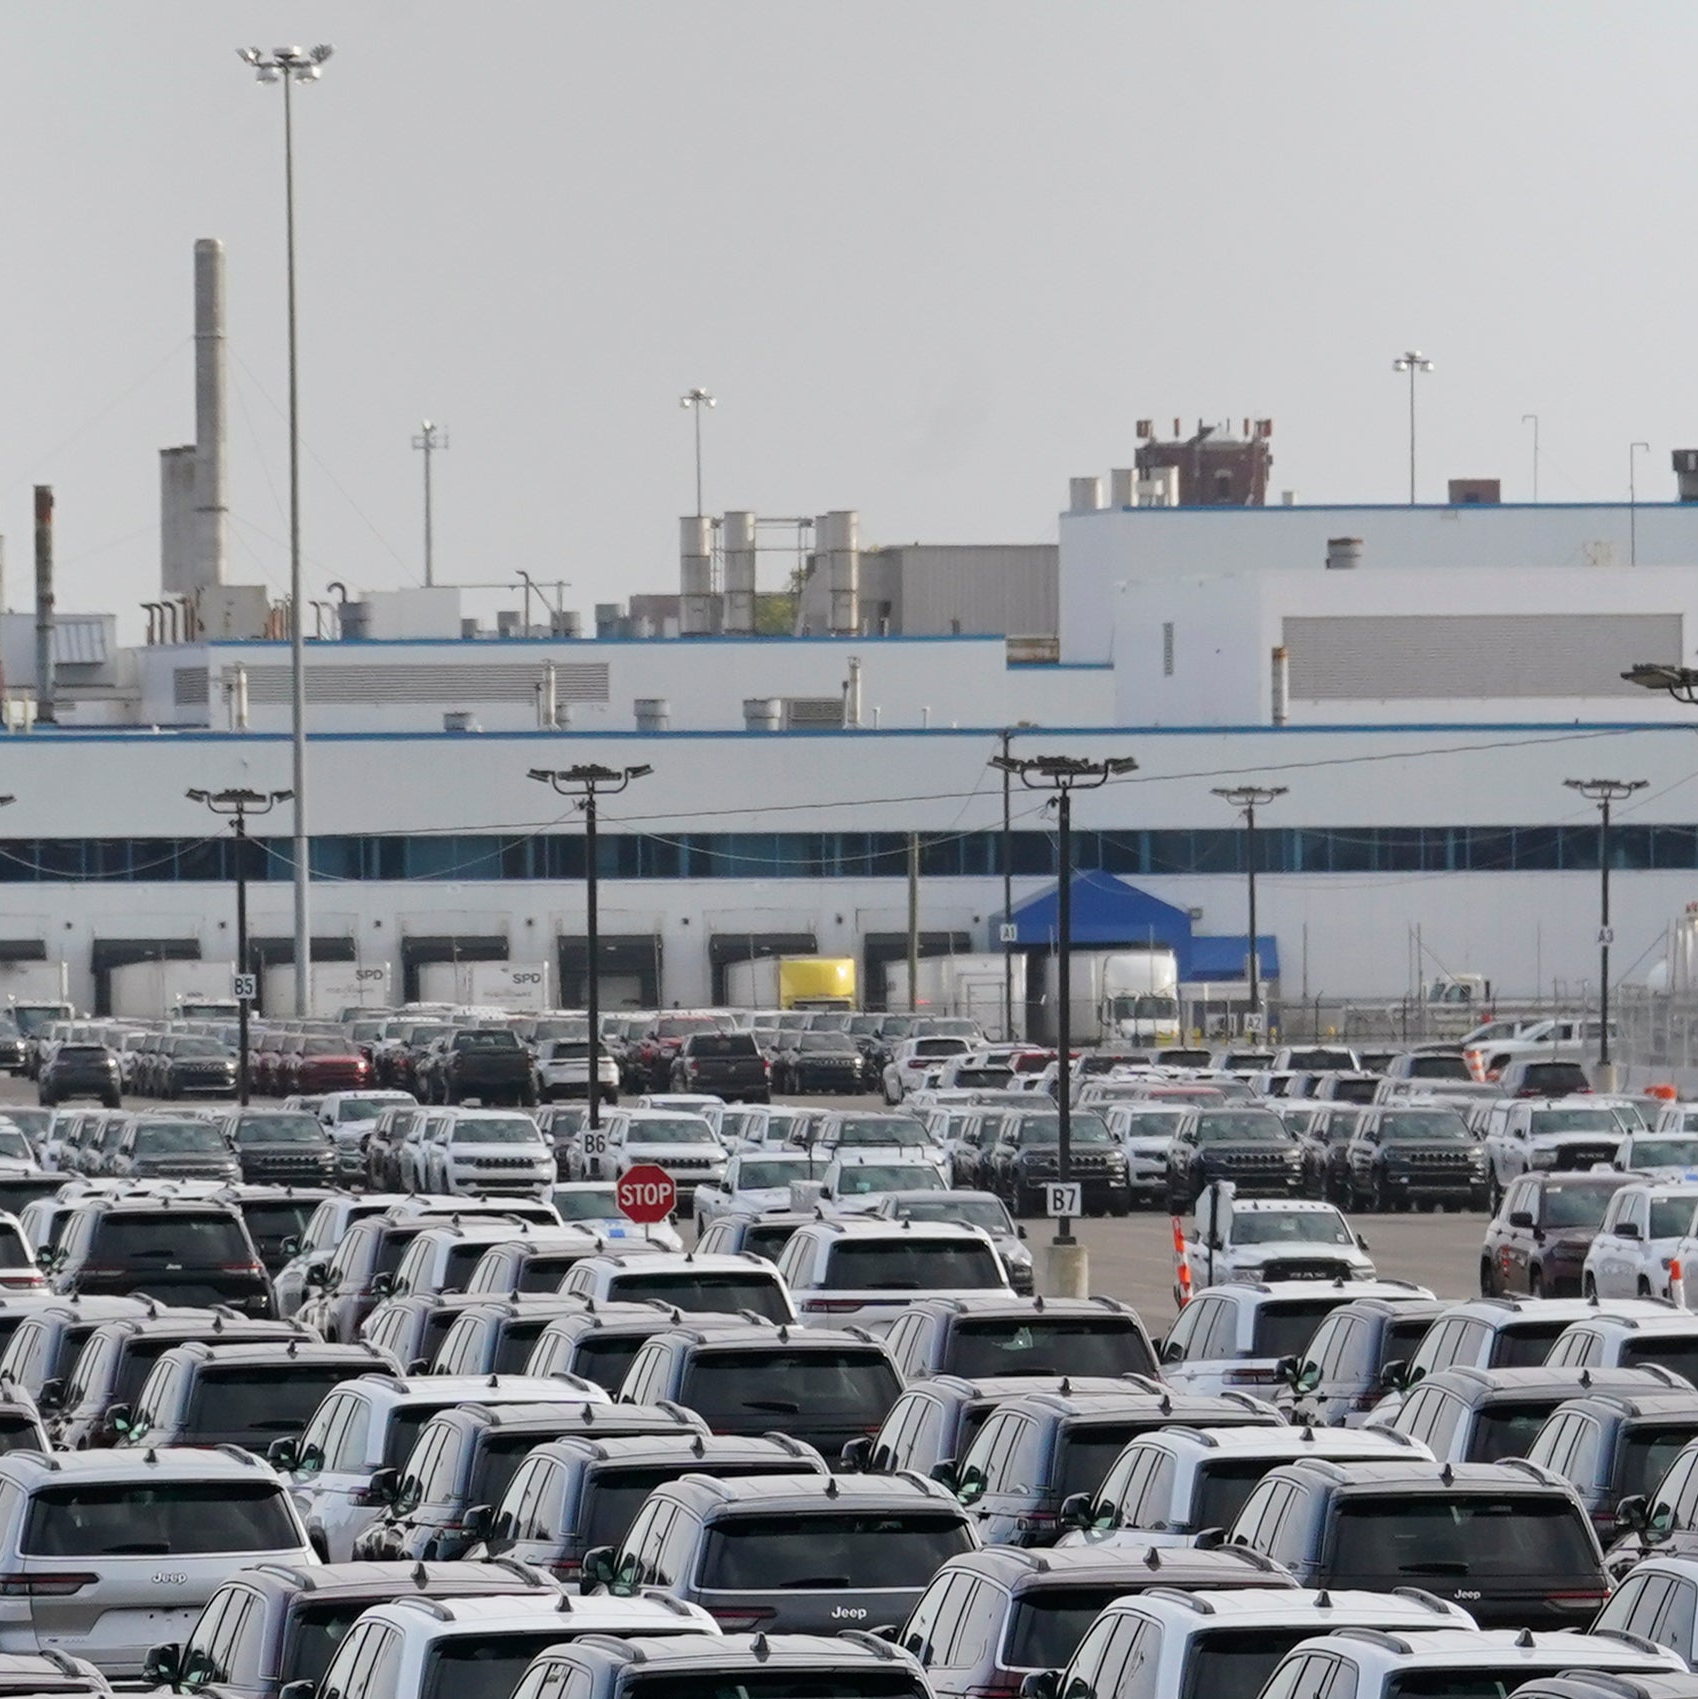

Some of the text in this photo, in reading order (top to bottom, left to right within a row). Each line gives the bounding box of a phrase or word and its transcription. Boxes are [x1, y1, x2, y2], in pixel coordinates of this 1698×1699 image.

[1003, 926, 1015, 939] A1
[355, 969, 383, 981] SPD
[512, 973, 541, 984] SPD
[234, 977, 253, 995] B5
[1247, 1016, 1261, 1031] A2
[584, 1134, 605, 1153] B6
[620, 1182, 671, 1206] STOP
[1052, 1189, 1075, 1211] B7
[152, 1570, 187, 1584] Jeep
[1454, 1589, 1481, 1600] Jeep
[831, 1606, 867, 1619] Jeep
